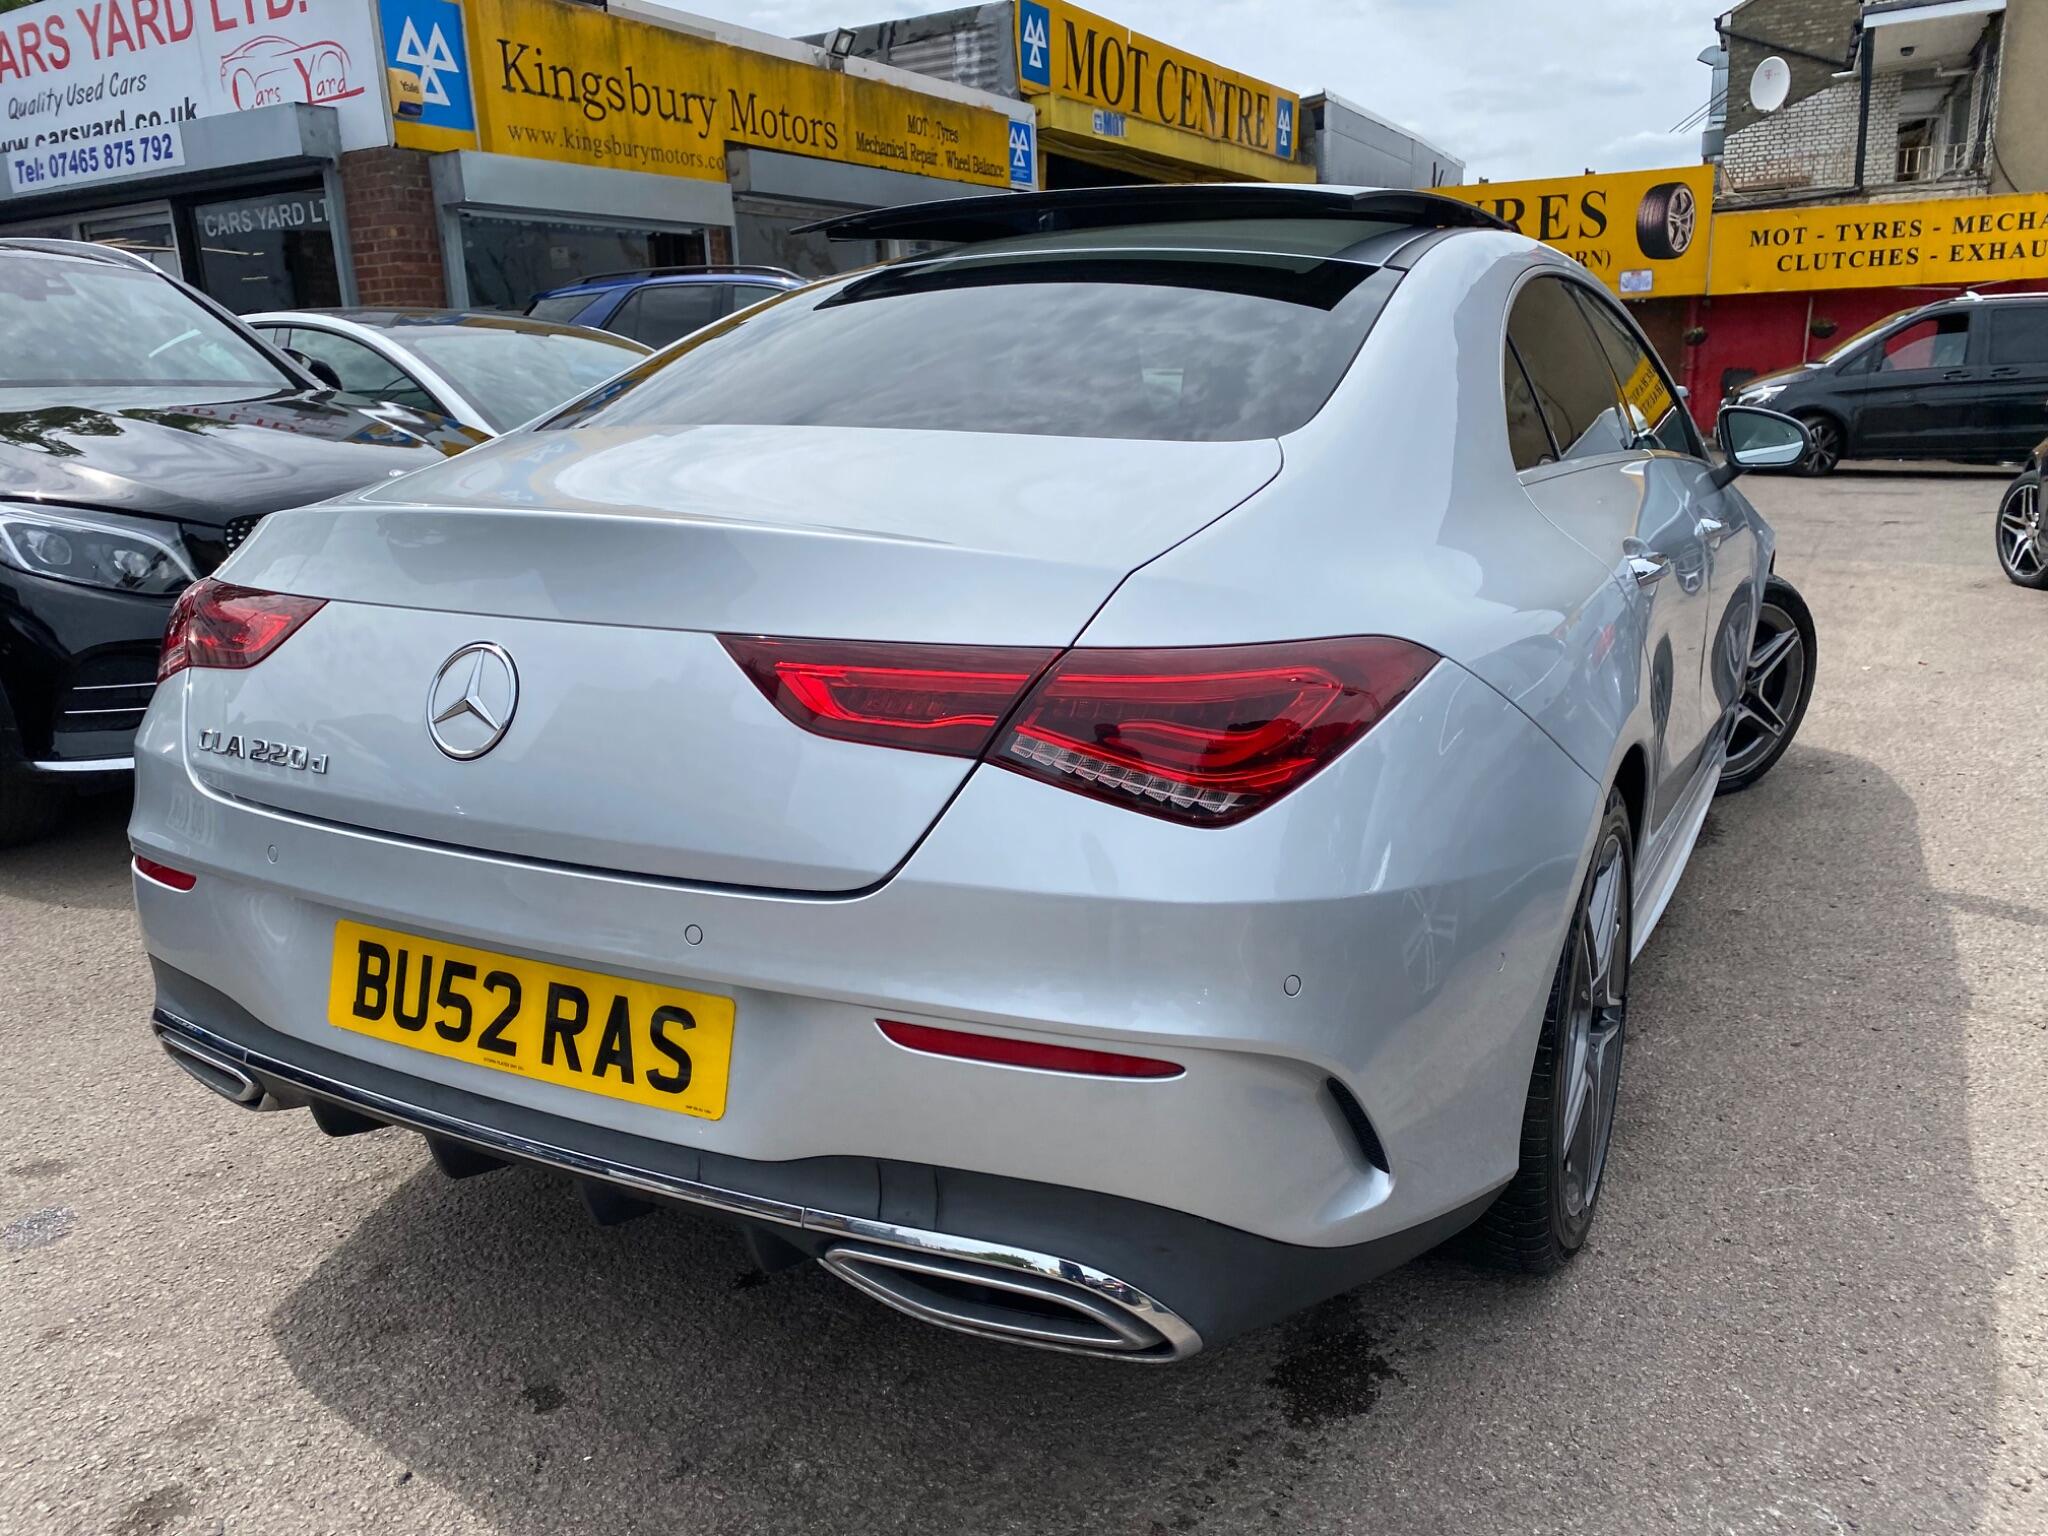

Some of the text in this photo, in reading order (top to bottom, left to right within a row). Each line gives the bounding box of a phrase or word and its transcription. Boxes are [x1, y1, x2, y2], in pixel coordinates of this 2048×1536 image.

[76, 0, 194, 60] YARD
[8, 72, 147, 120] Quality Used Cars
[232, 51, 364, 111] Cars Yard
[496, 38, 839, 150] Kingsbury Motors
[1062, 18, 1270, 149] MOT CENTRE
[507, 124, 725, 170] www.kingsburymotors.co
[907, 115, 959, 145] MOT Tyres
[15, 133, 174, 184] Tel: 07465 875 792
[856, 131, 908, 160] Mechanical
[910, 143, 938, 168] Repair
[946, 150, 972, 173] Wheel
[973, 154, 1005, 178] Balance
[204, 210, 252, 237] CARS
[255, 202, 305, 230] YARD
[1475, 190, 1608, 241] RES
[1750, 226, 1807, 248] MOT
[1835, 219, 1923, 242] TYRES
[1776, 247, 1920, 272] CLUTCHES
[1948, 239, 2048, 263] EXHAU
[198, 728, 246, 760] CLA
[352, 940, 697, 1095] BU52 RAS
